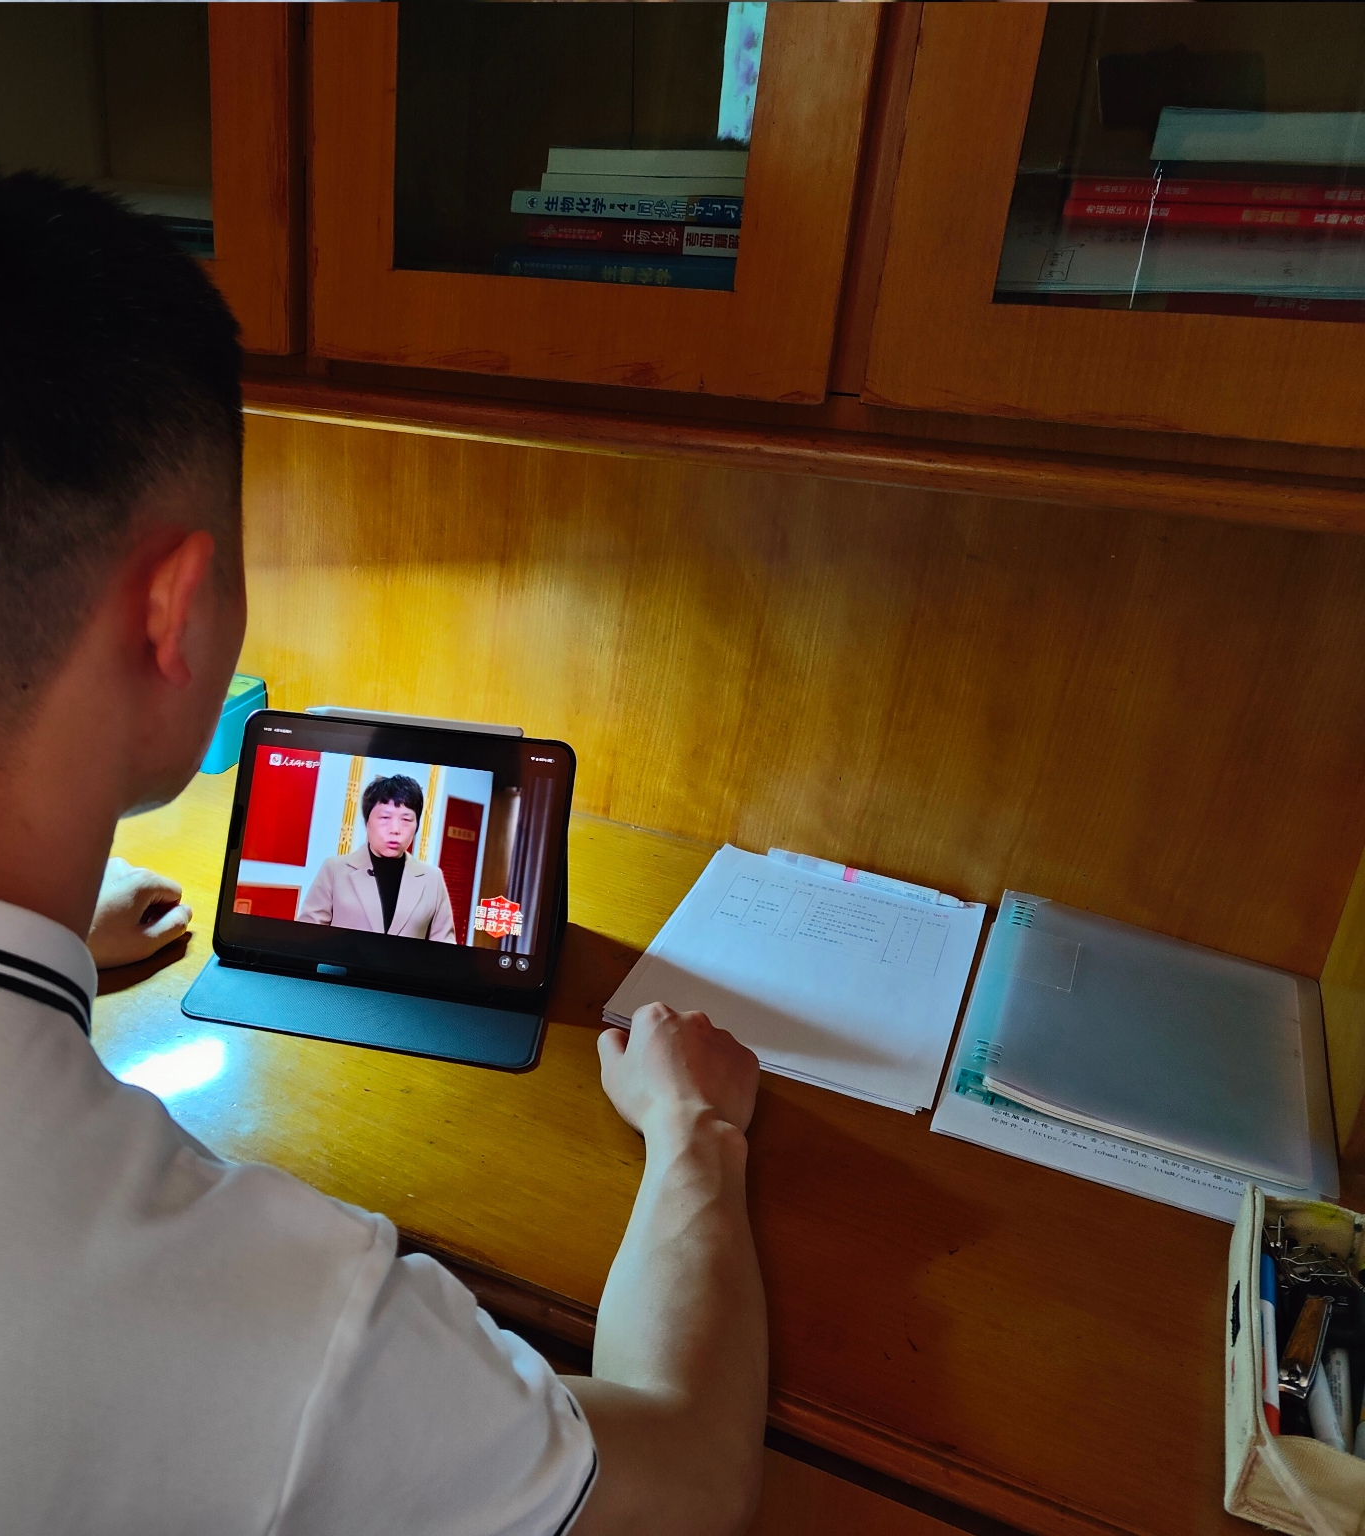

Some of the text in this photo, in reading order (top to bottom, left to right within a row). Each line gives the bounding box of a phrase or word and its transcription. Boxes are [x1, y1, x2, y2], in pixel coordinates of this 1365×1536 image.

[544, 195, 607, 214] 生物化学
[637, 198, 743, 221] 同步辅导与习
[622, 228, 680, 247] 生物化学
[475, 905, 525, 924] 国家安全
[472, 918, 523, 937] 思政大课
